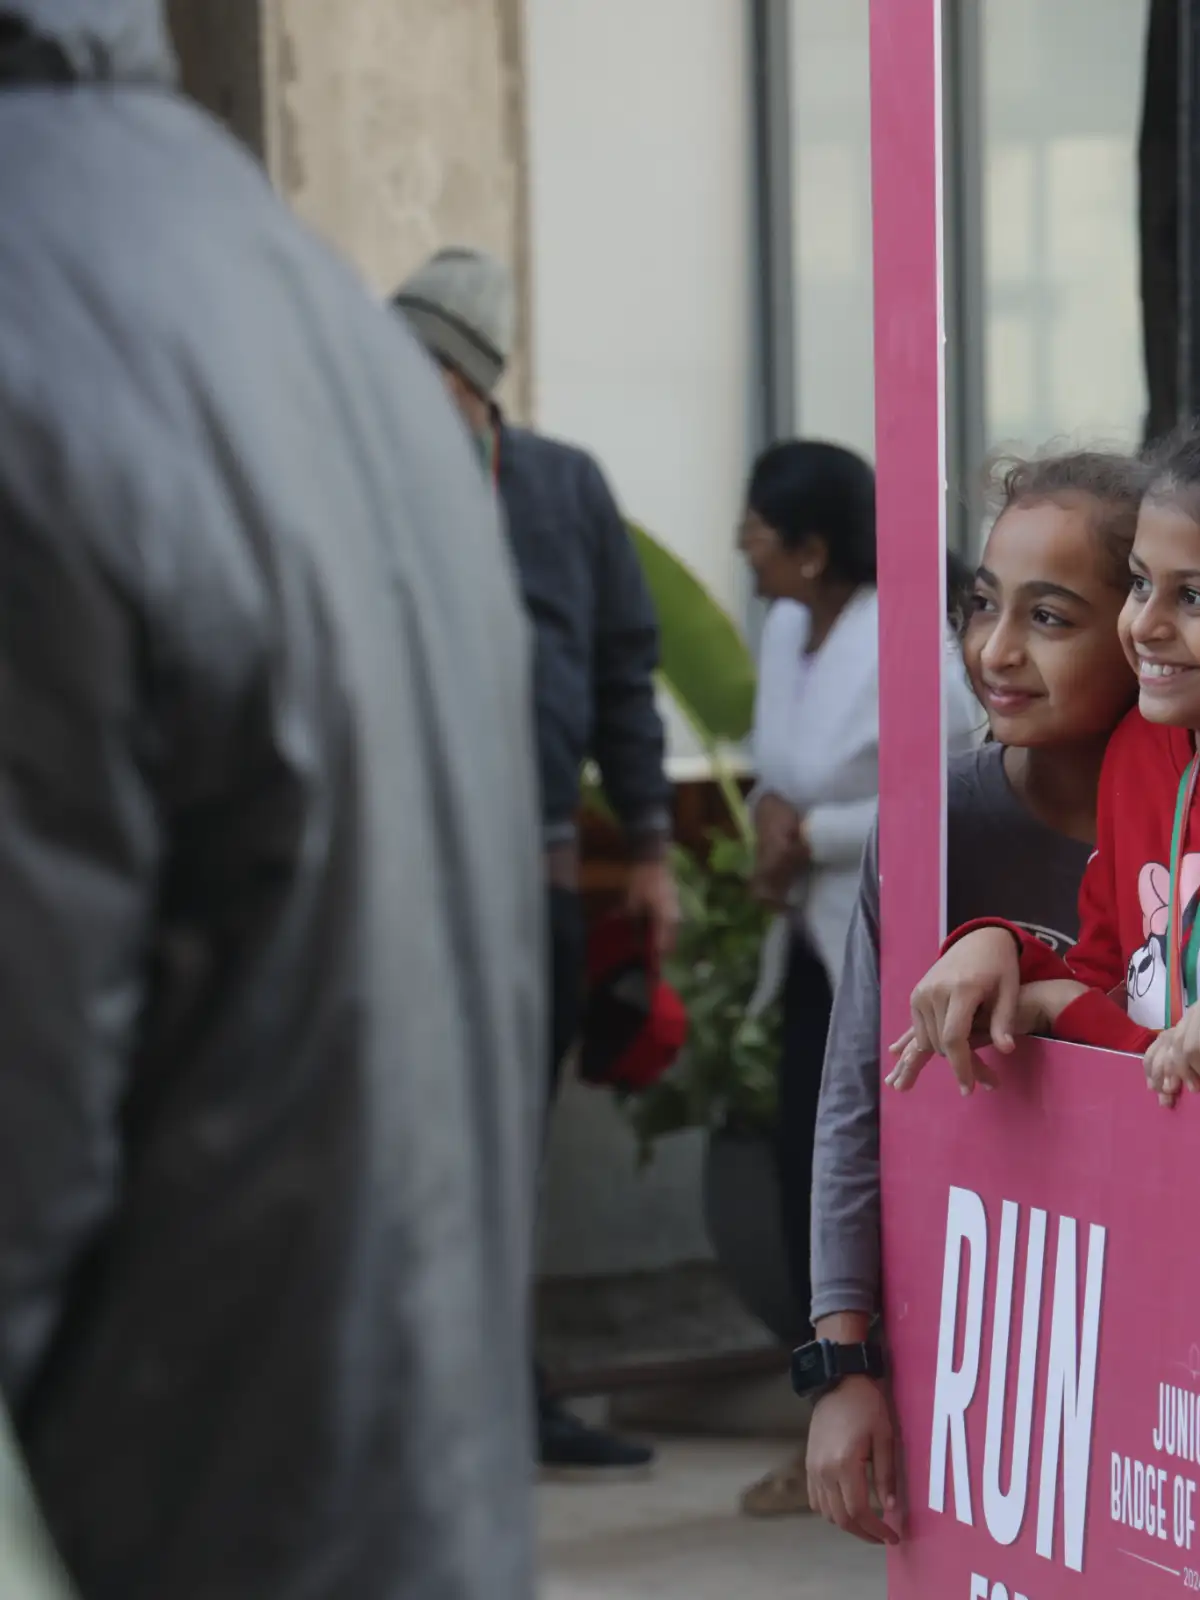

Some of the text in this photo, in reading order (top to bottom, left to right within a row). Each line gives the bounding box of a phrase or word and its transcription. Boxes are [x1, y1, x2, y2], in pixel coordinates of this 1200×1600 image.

[928, 1184, 1107, 1573] RUN
[1110, 1451, 1168, 1541] BADGE
[1173, 1474, 1196, 1550] OF
